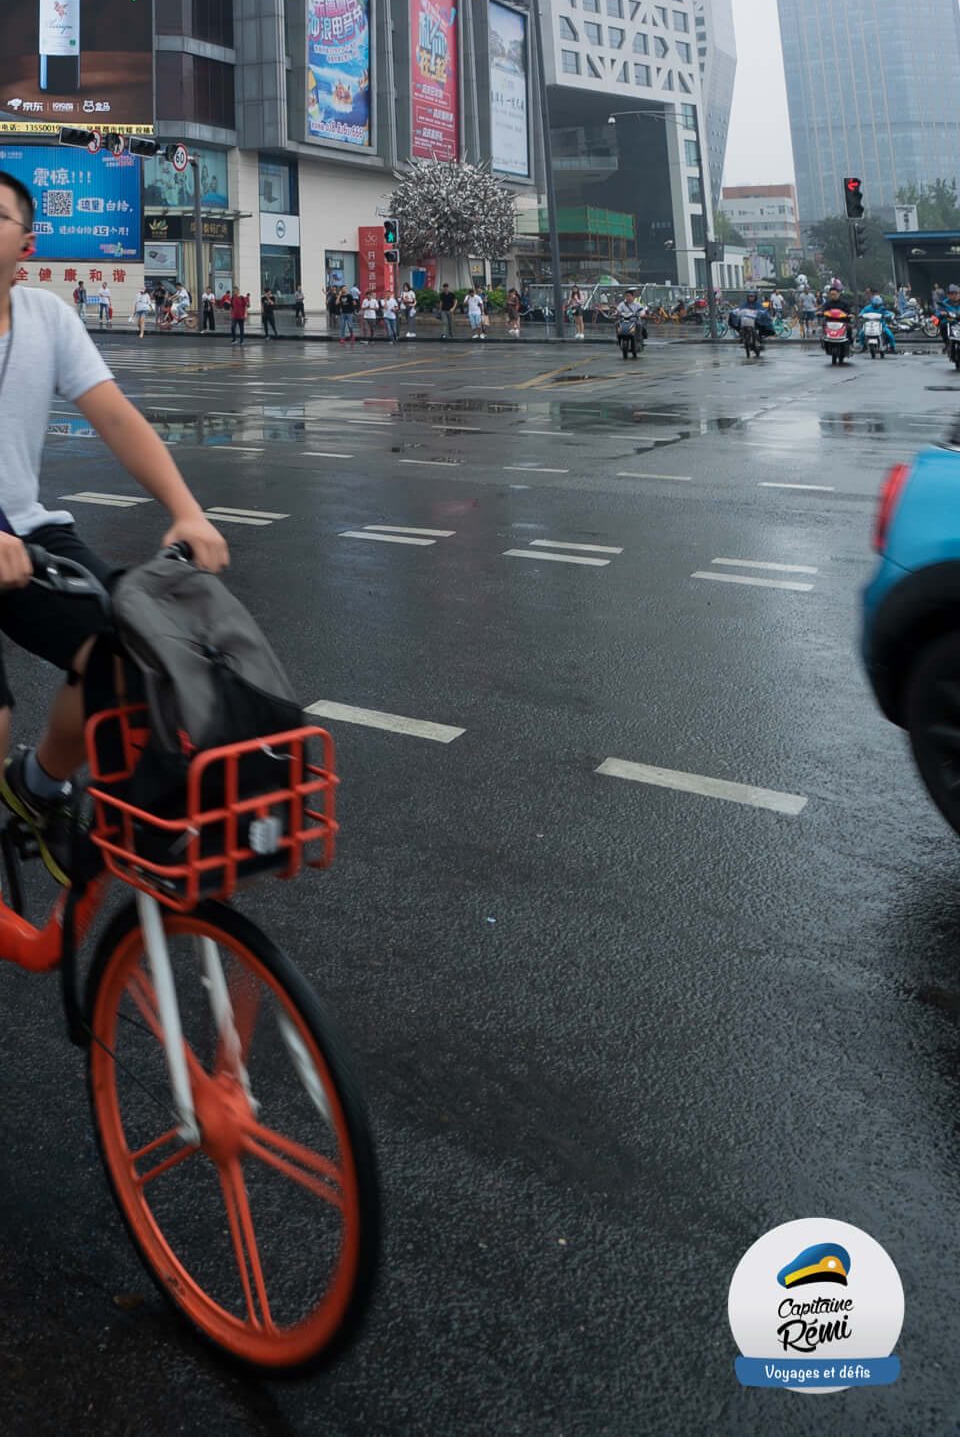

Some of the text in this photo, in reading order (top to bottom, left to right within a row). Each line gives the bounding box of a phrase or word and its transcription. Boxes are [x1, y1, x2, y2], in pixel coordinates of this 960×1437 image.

[175, 152, 184, 163] 60
[191, 222, 228, 235] 成数码广场
